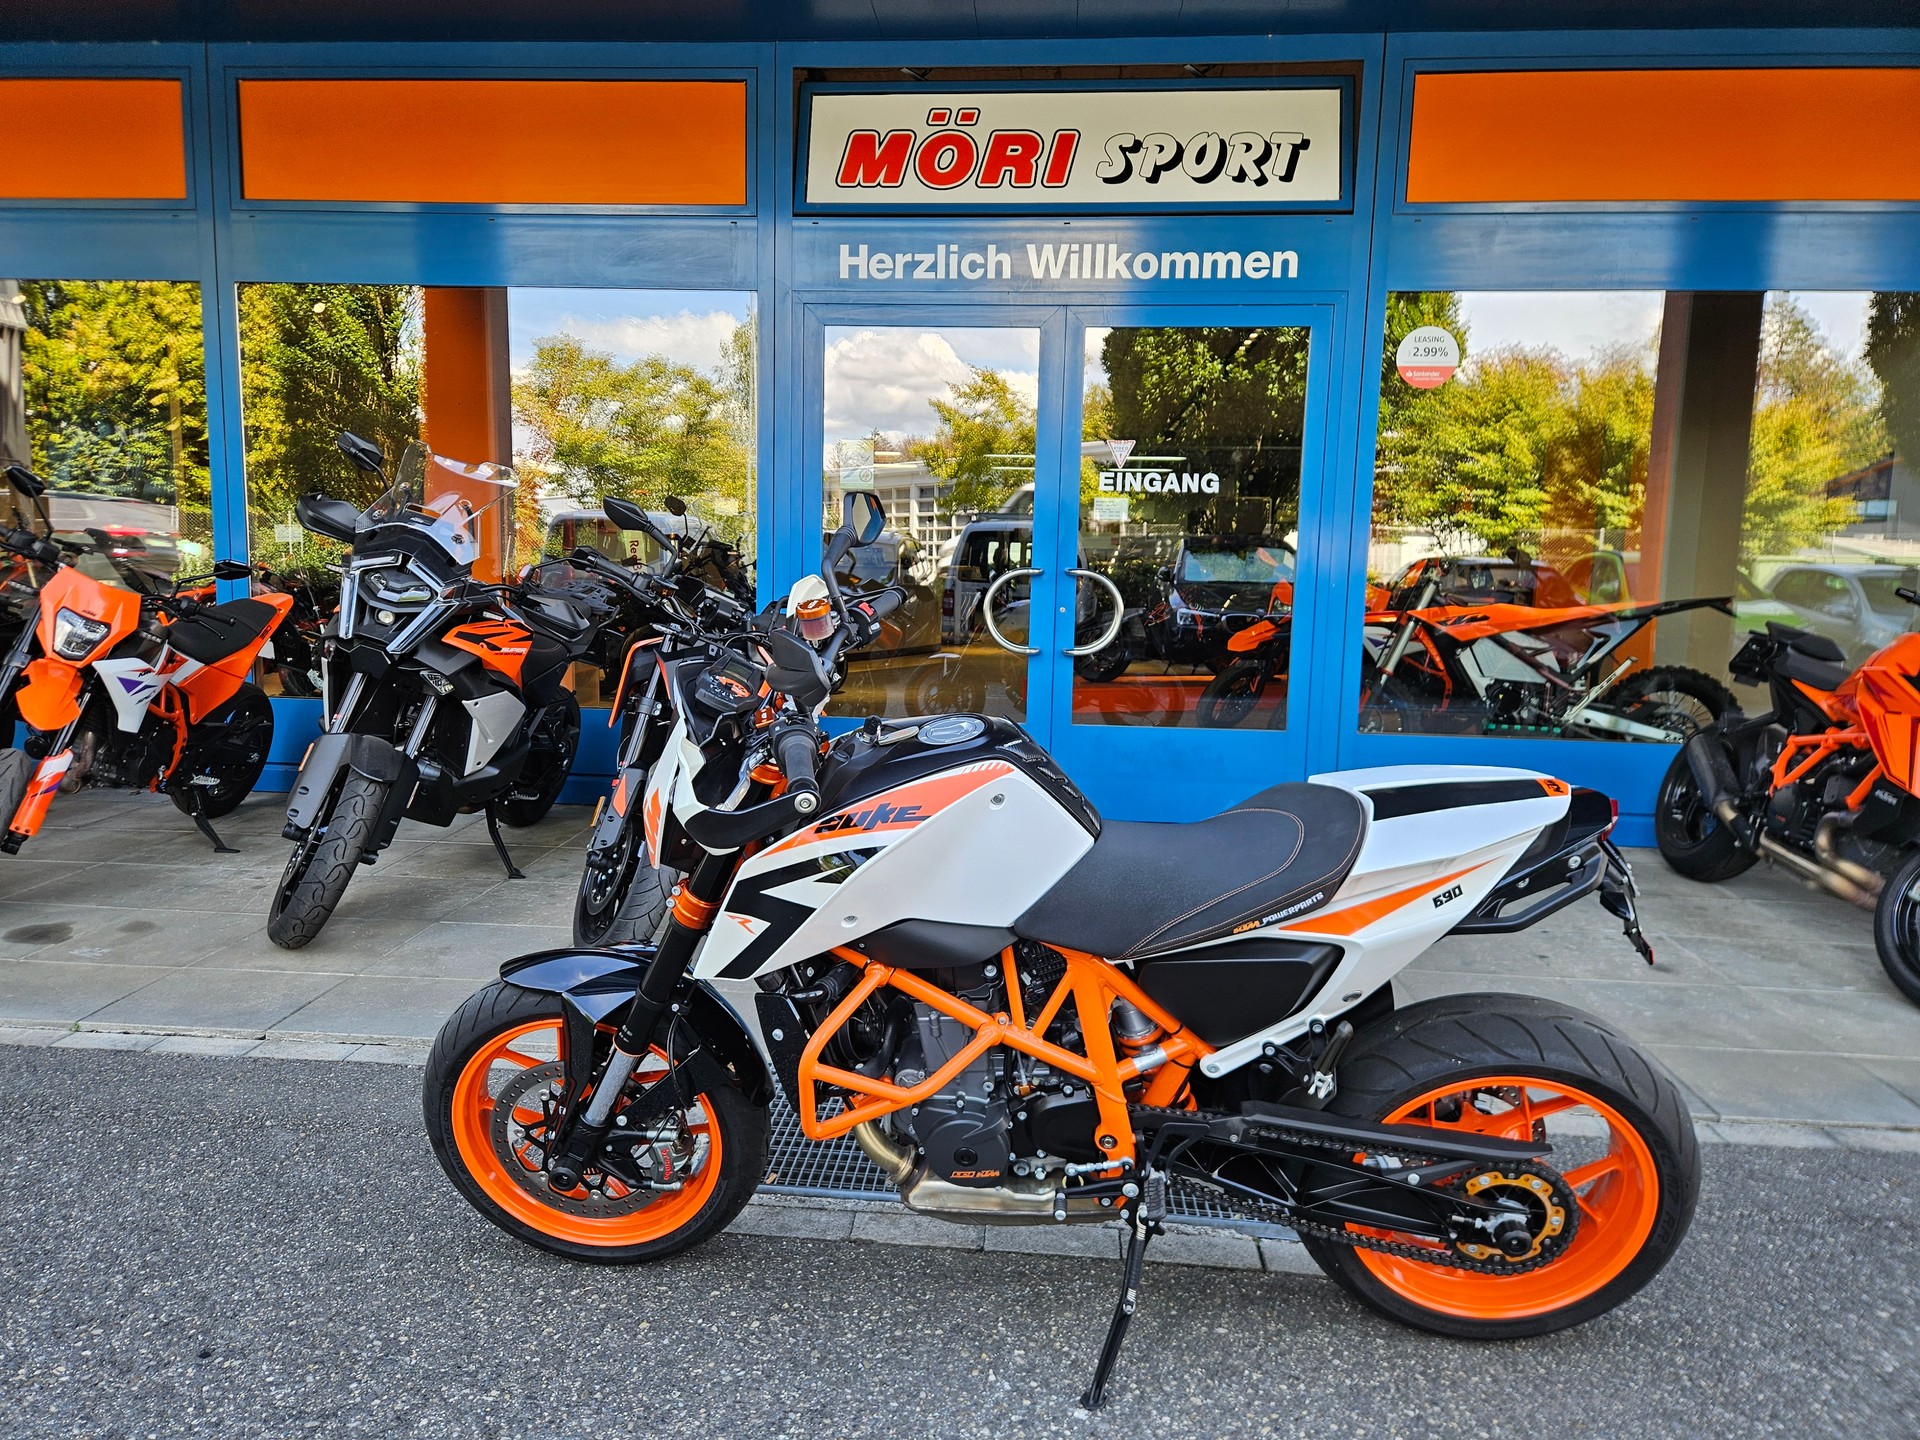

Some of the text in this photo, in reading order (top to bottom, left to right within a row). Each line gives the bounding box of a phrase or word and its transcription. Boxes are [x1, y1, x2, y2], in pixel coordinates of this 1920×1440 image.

[835, 107, 1310, 190] MÖRI SPORT
[839, 243, 1298, 280] Herzlich Willkommen
[1413, 346, 1449, 357] 2.99%
[1414, 335, 1445, 343] LEASING
[1100, 471, 1220, 494] EINGANG
[1432, 884, 1464, 909] 690
[1233, 892, 1325, 934] KTM POWERPARTS
